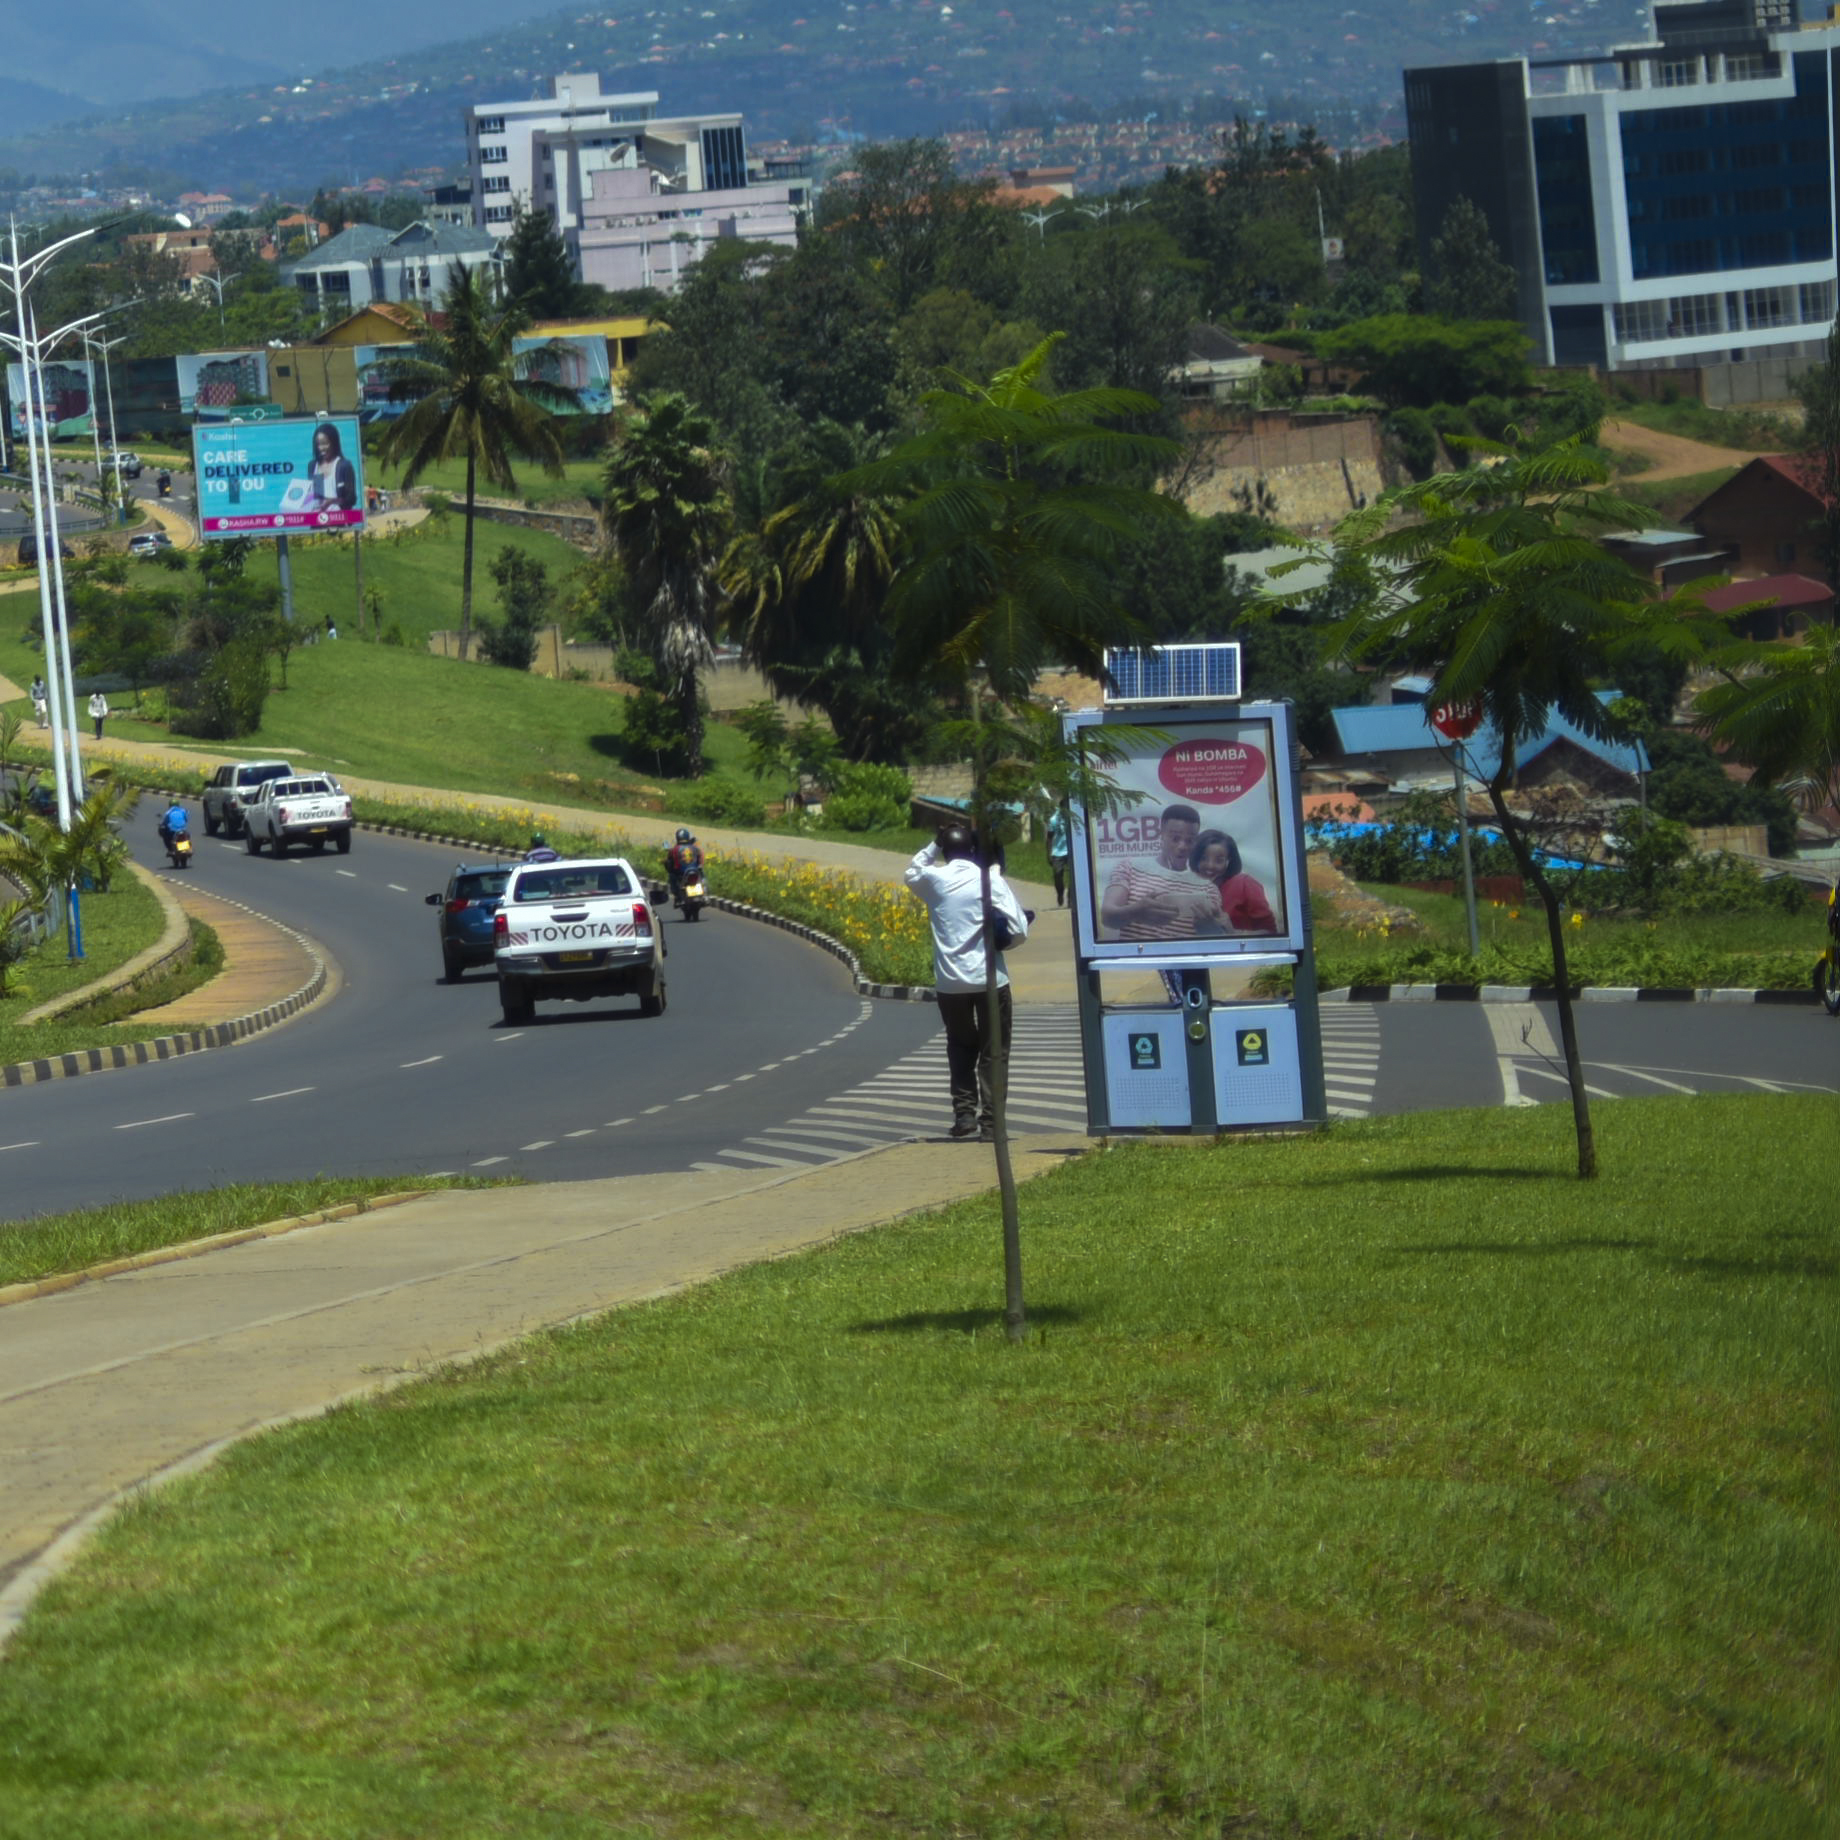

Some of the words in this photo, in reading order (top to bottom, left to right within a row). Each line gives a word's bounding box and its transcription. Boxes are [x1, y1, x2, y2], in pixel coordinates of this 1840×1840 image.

[203, 449, 248, 465] CARE
[204, 462, 295, 479] DELIVERED
[205, 480, 228, 493] TO
[1194, 748, 1248, 762] BOMBA
[1185, 785, 1214, 795] Kanda
[296, 808, 337, 821] TOYOTA
[1097, 816, 1161, 843] 1GB
[1099, 843, 1125, 854] BURI
[530, 923, 613, 942] TOYOTA
